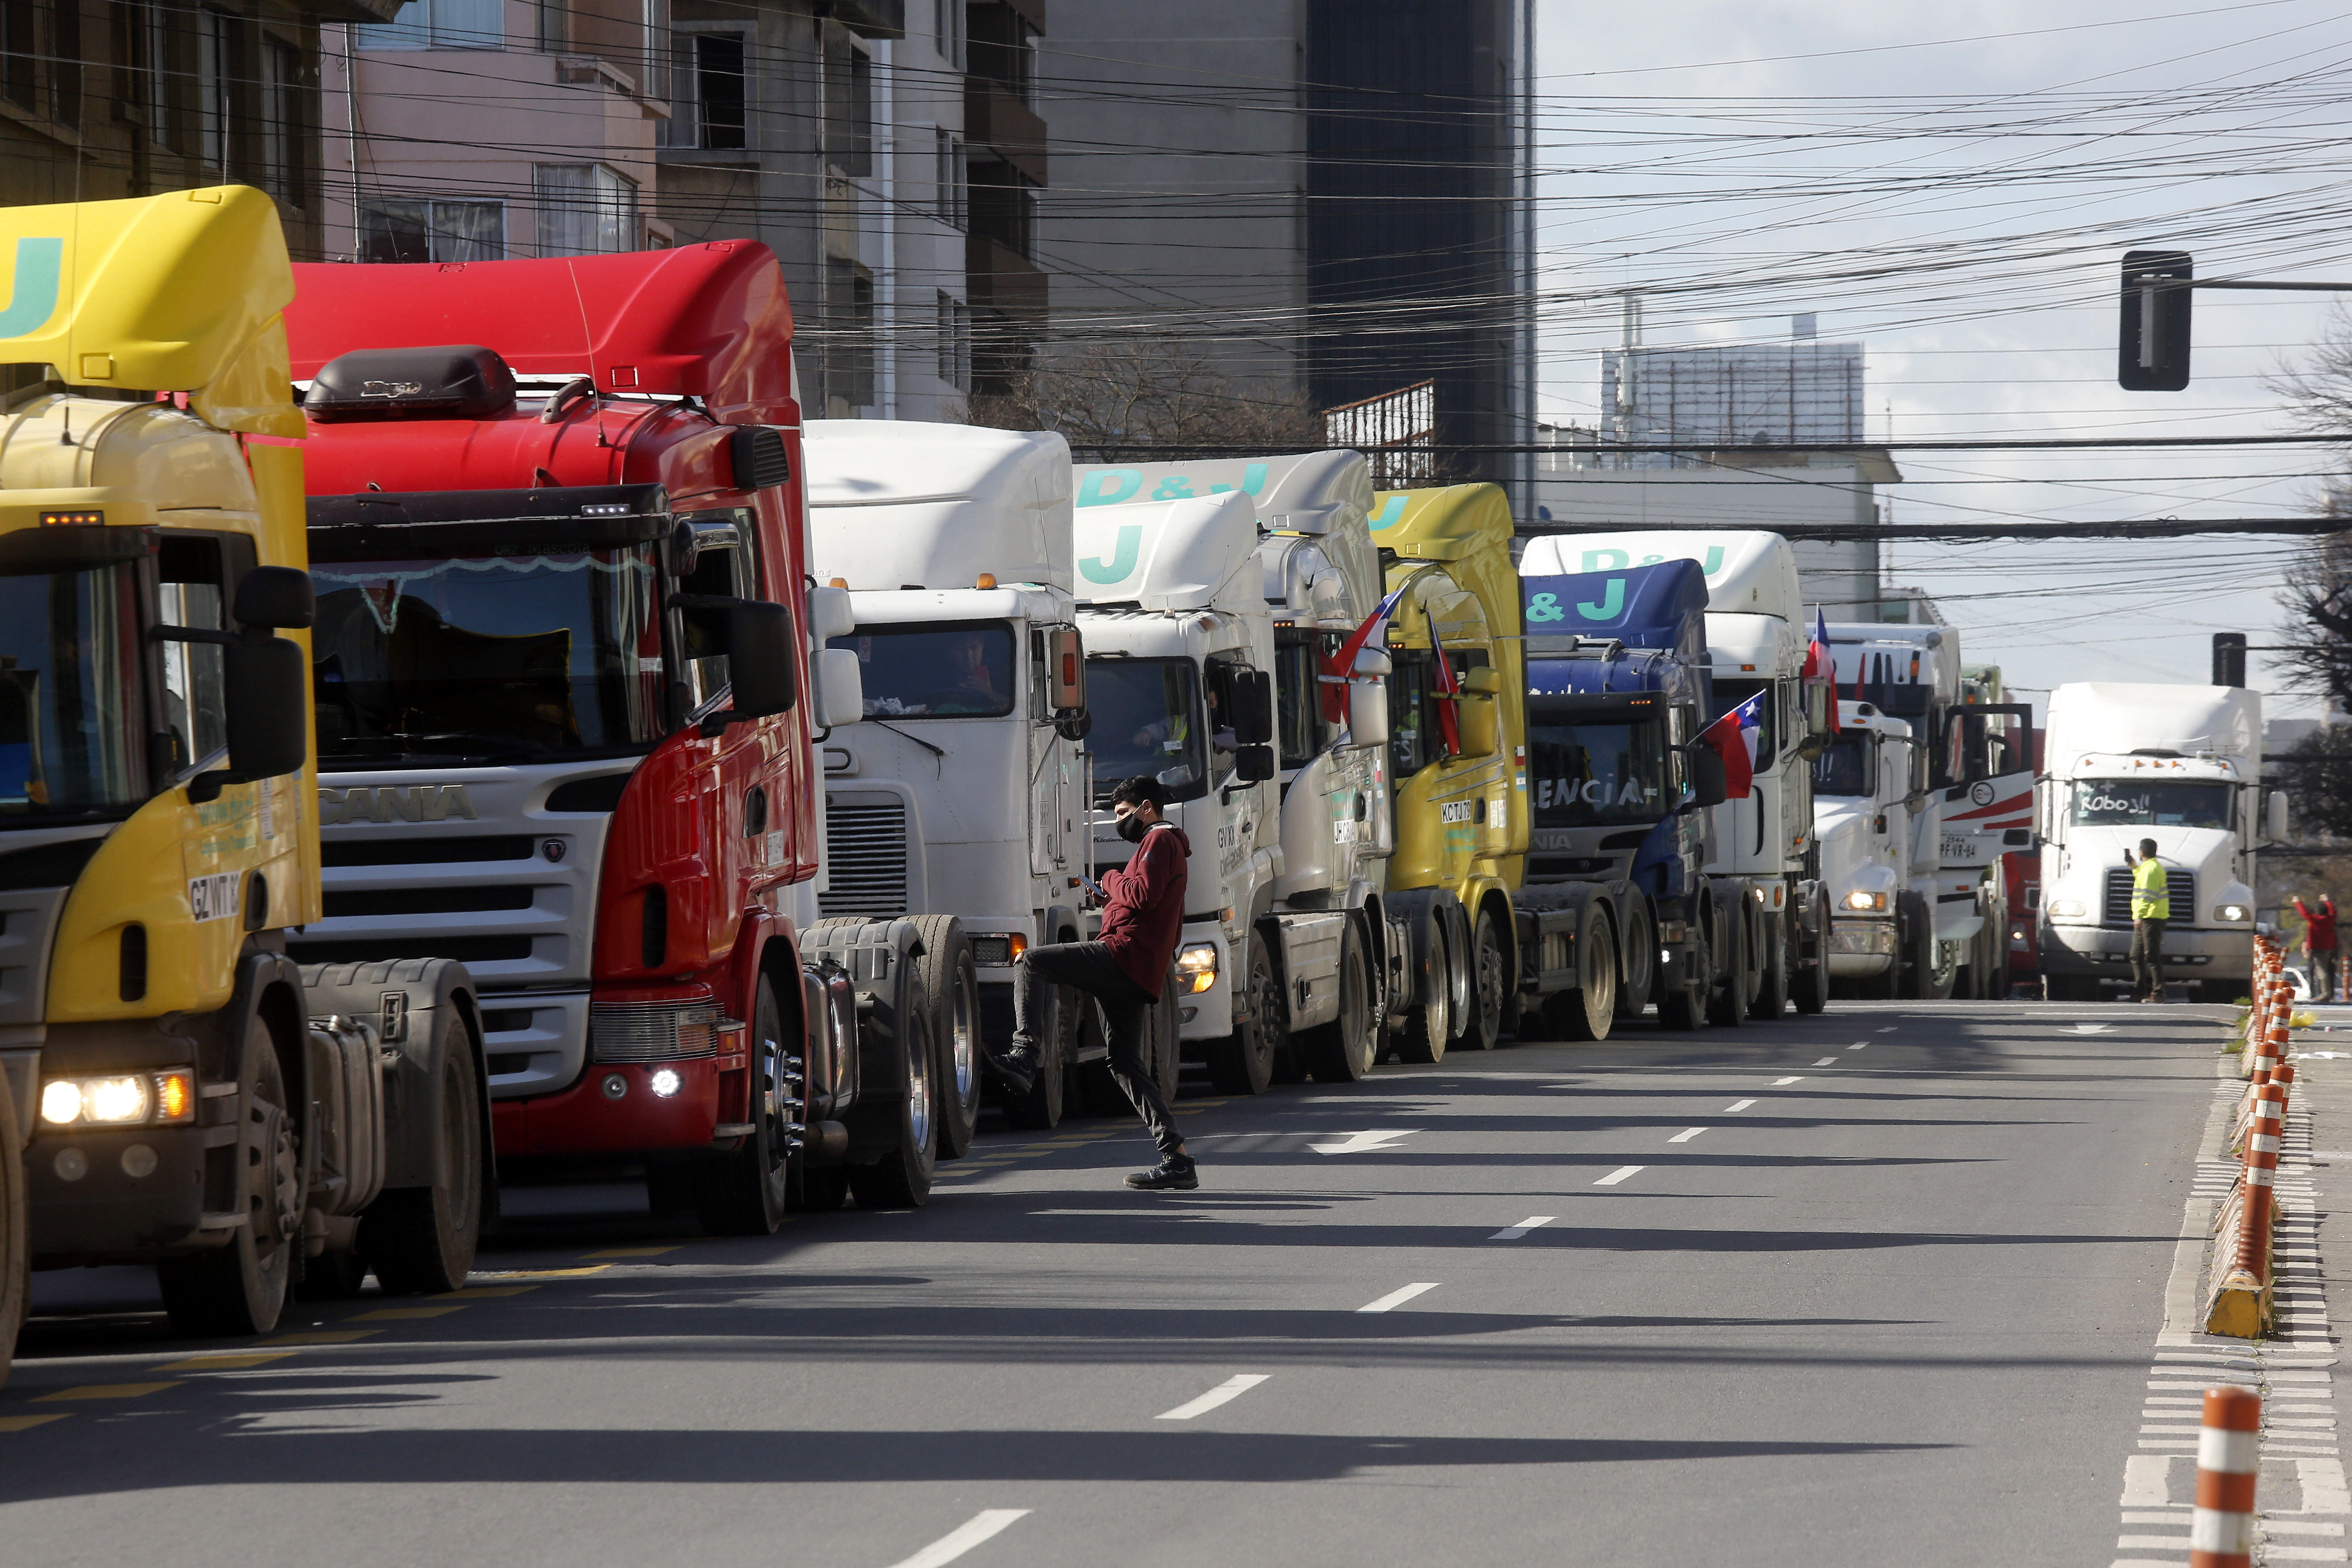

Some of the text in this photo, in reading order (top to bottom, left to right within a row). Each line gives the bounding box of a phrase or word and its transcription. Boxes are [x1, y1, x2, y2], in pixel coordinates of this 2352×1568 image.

[1077, 463, 1269, 507] D & J
[1078, 525, 1142, 584] J
[1526, 578, 1626, 622] & J
[317, 785, 478, 825] CANIA
